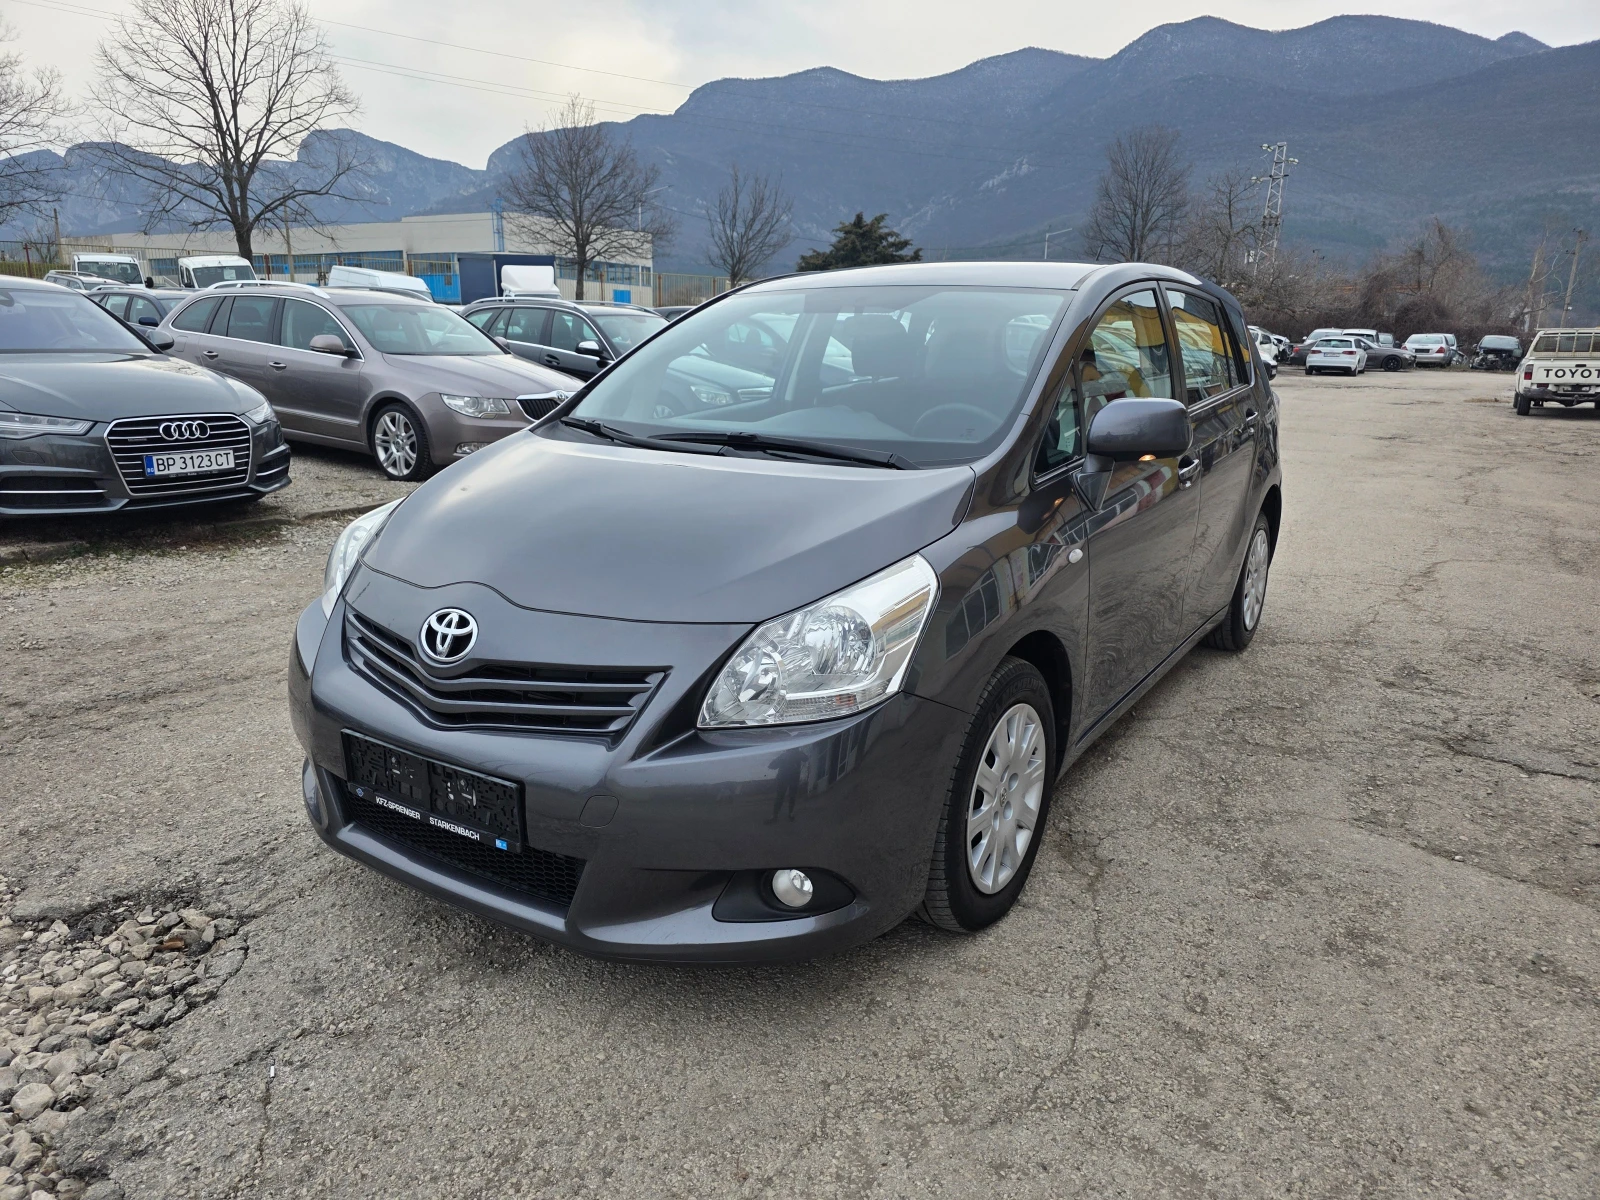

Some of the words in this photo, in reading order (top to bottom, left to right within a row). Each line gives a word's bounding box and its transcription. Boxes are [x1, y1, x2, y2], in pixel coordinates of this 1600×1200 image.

[155, 457, 176, 472] BP
[179, 454, 213, 470] 3123
[215, 452, 231, 467] CT
[429, 816, 480, 841] STARKENBACH
